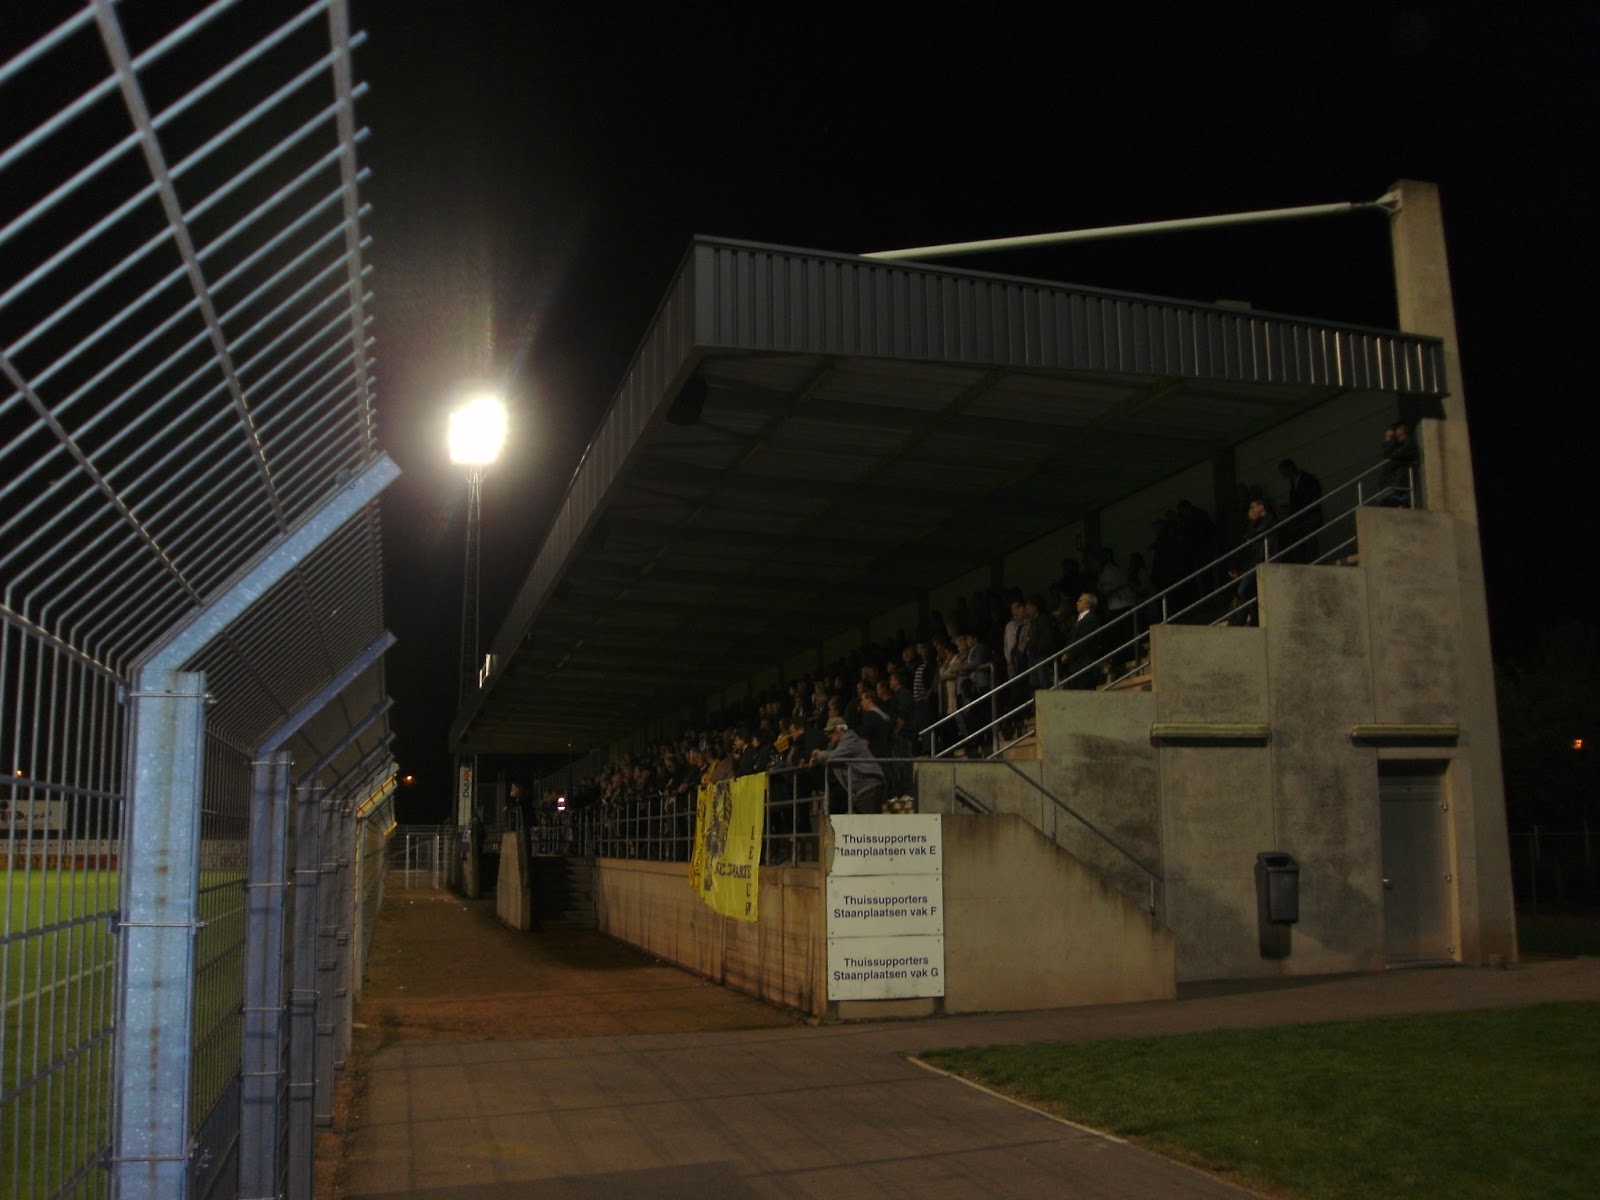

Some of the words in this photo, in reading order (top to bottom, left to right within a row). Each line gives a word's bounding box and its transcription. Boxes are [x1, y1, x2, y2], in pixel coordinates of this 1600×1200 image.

[842, 834, 927, 845] Thuissupporters
[909, 846, 927, 855] vak
[930, 845, 936, 855] E
[843, 895, 928, 906] Thuissupporters
[834, 908, 907, 919] Staanplaatsen
[910, 907, 927, 916] vak
[930, 906, 937, 916] F
[844, 956, 929, 968] Thuissupporters
[833, 970, 907, 981] Staanplaatsen
[910, 968, 928, 978] vak
[931, 967, 939, 977] G
